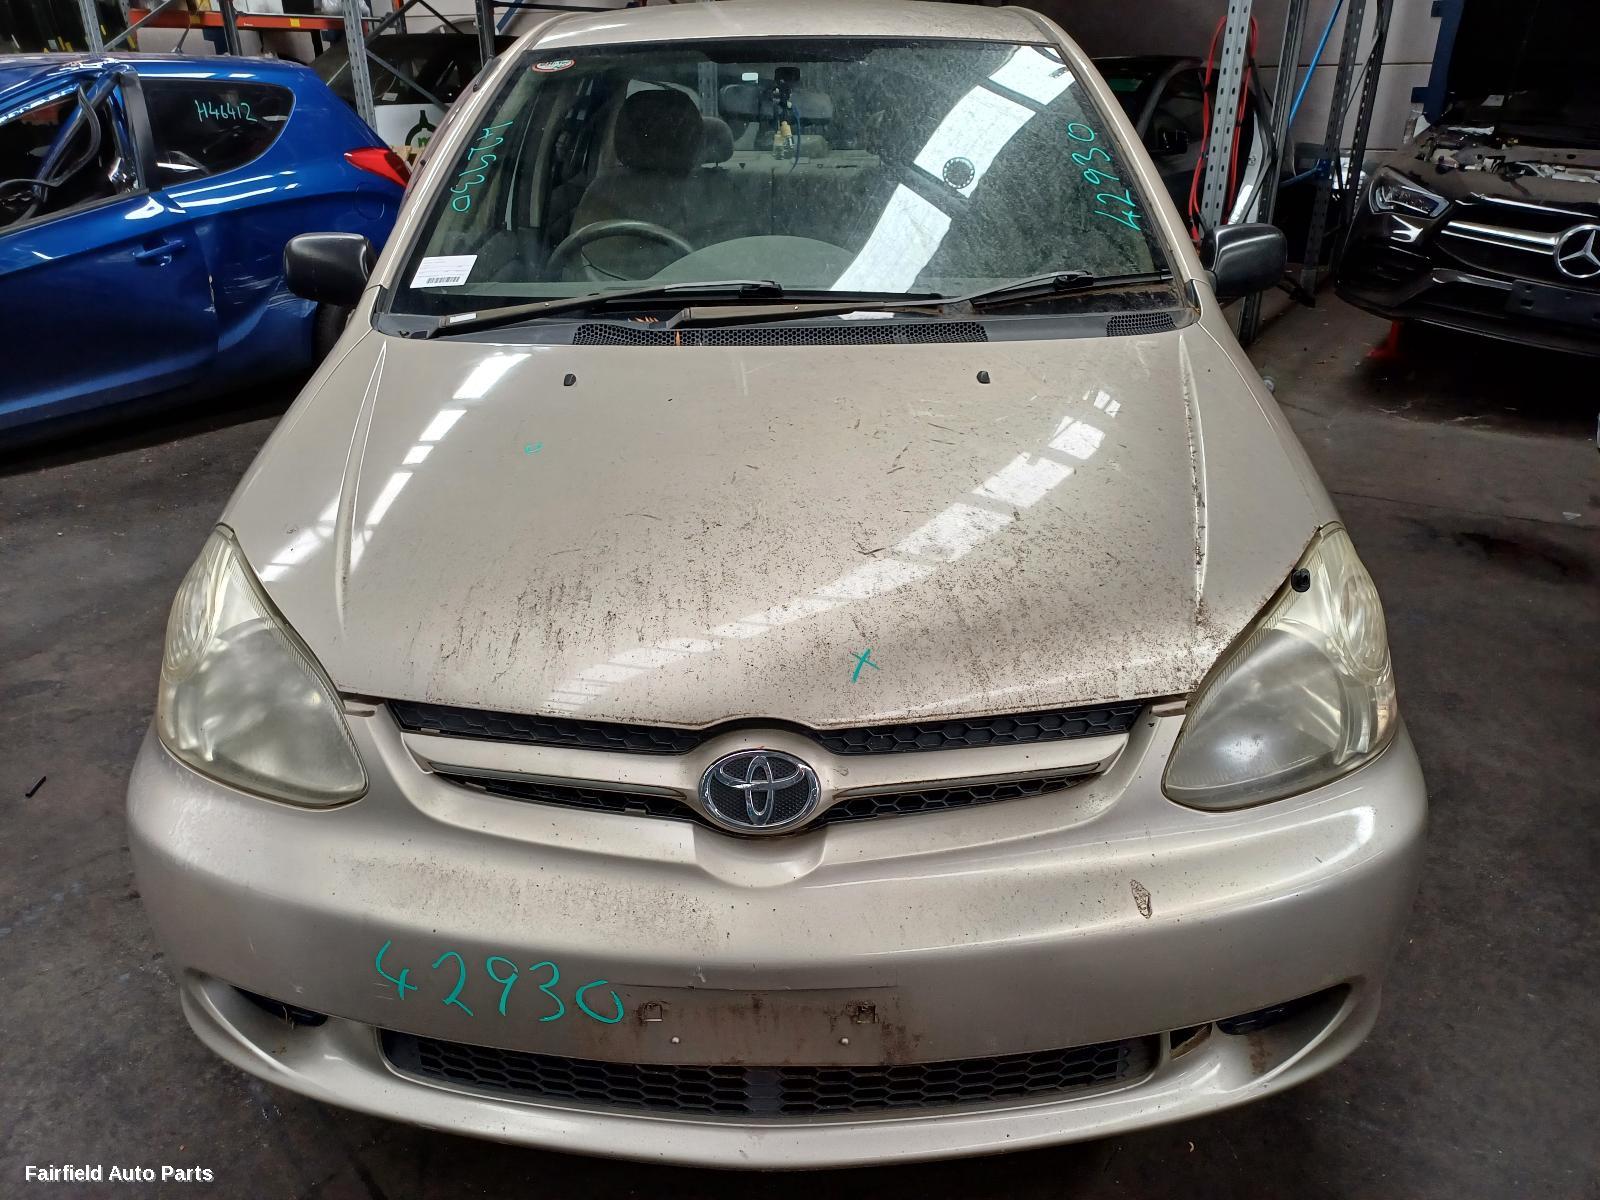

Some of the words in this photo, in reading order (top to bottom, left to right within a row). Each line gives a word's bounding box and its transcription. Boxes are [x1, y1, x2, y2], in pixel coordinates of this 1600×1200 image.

[194, 99, 258, 123] H46412
[1066, 122, 1142, 231] 42930
[375, 939, 625, 1024] 42930
